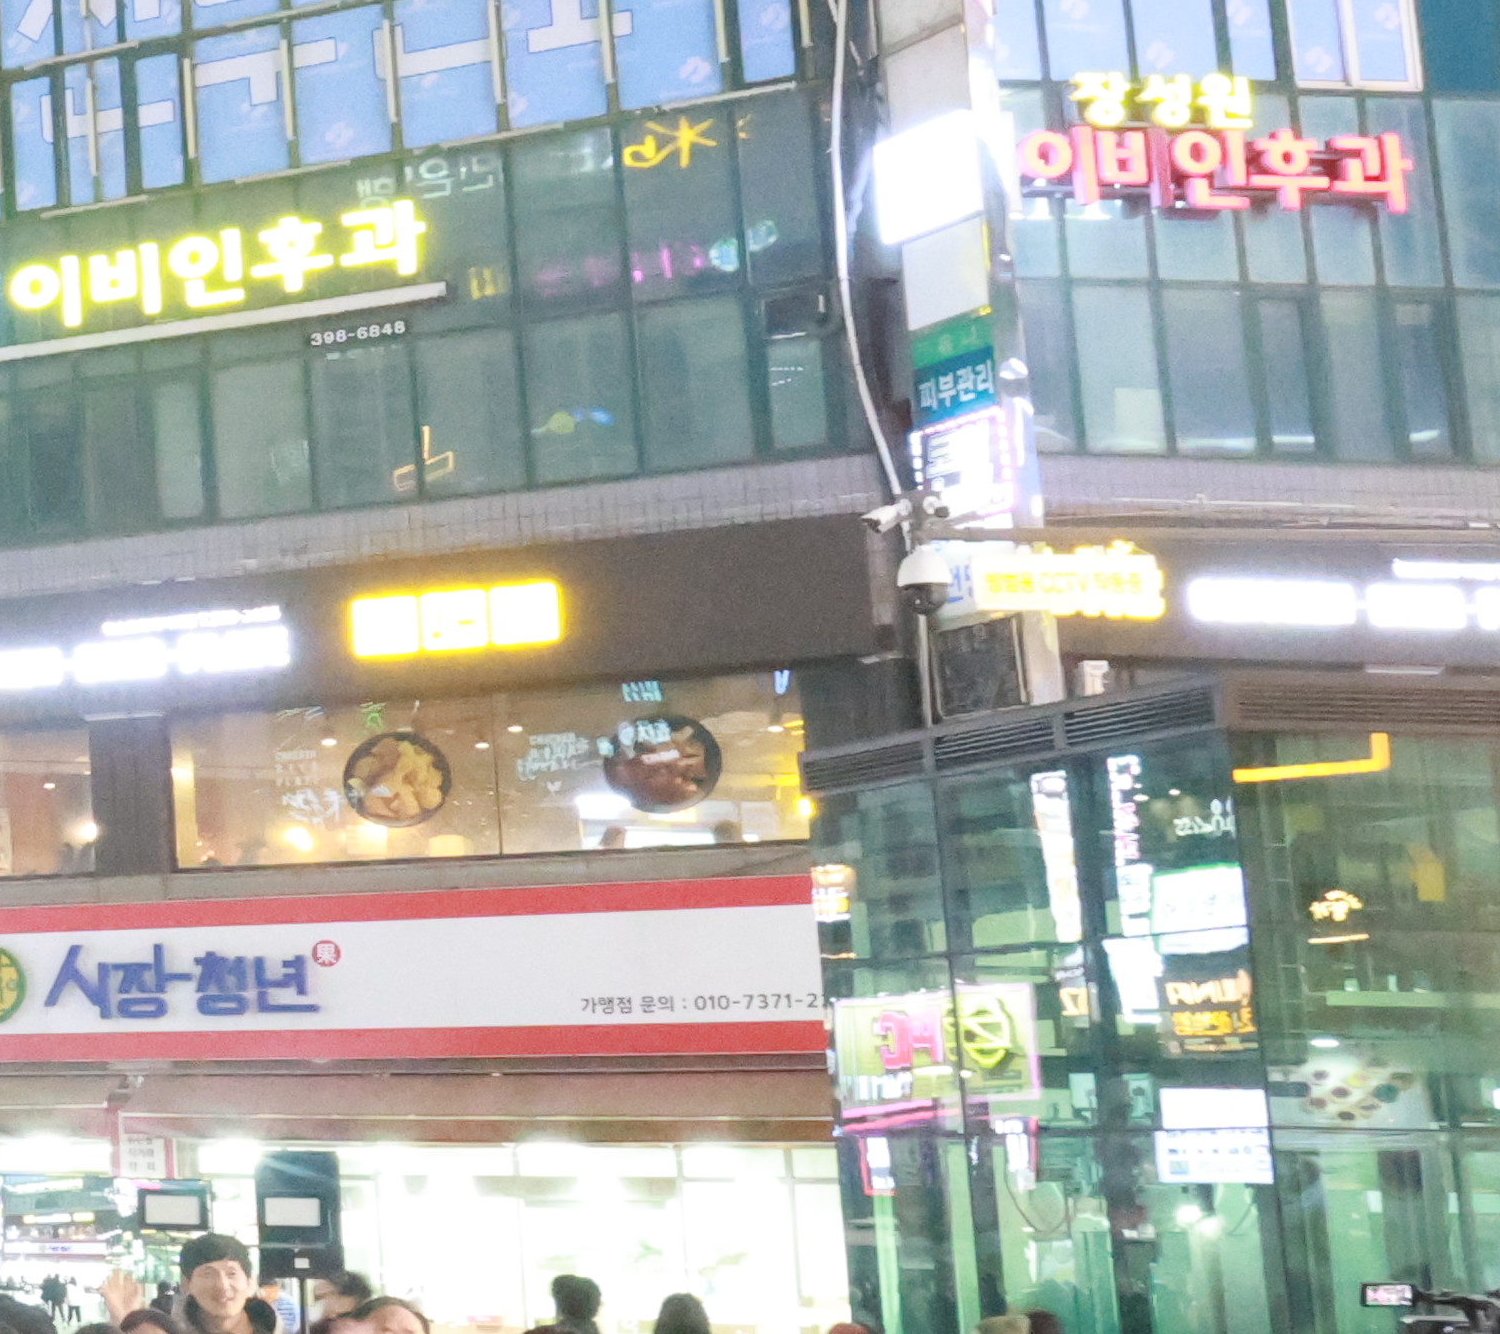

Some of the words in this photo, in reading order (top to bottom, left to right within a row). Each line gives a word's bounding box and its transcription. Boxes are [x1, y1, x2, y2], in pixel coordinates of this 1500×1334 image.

[1069, 72, 1253, 130] 장성원
[1018, 128, 1414, 215] 이비인후과
[5, 201, 429, 329] 이비인후과
[310, 320, 407, 348] 398-6848
[918, 359, 996, 411] 피부관리
[44, 943, 320, 1020] 시장청년
[581, 993, 635, 1015] 가맹점
[639, 993, 676, 1014] 문의
